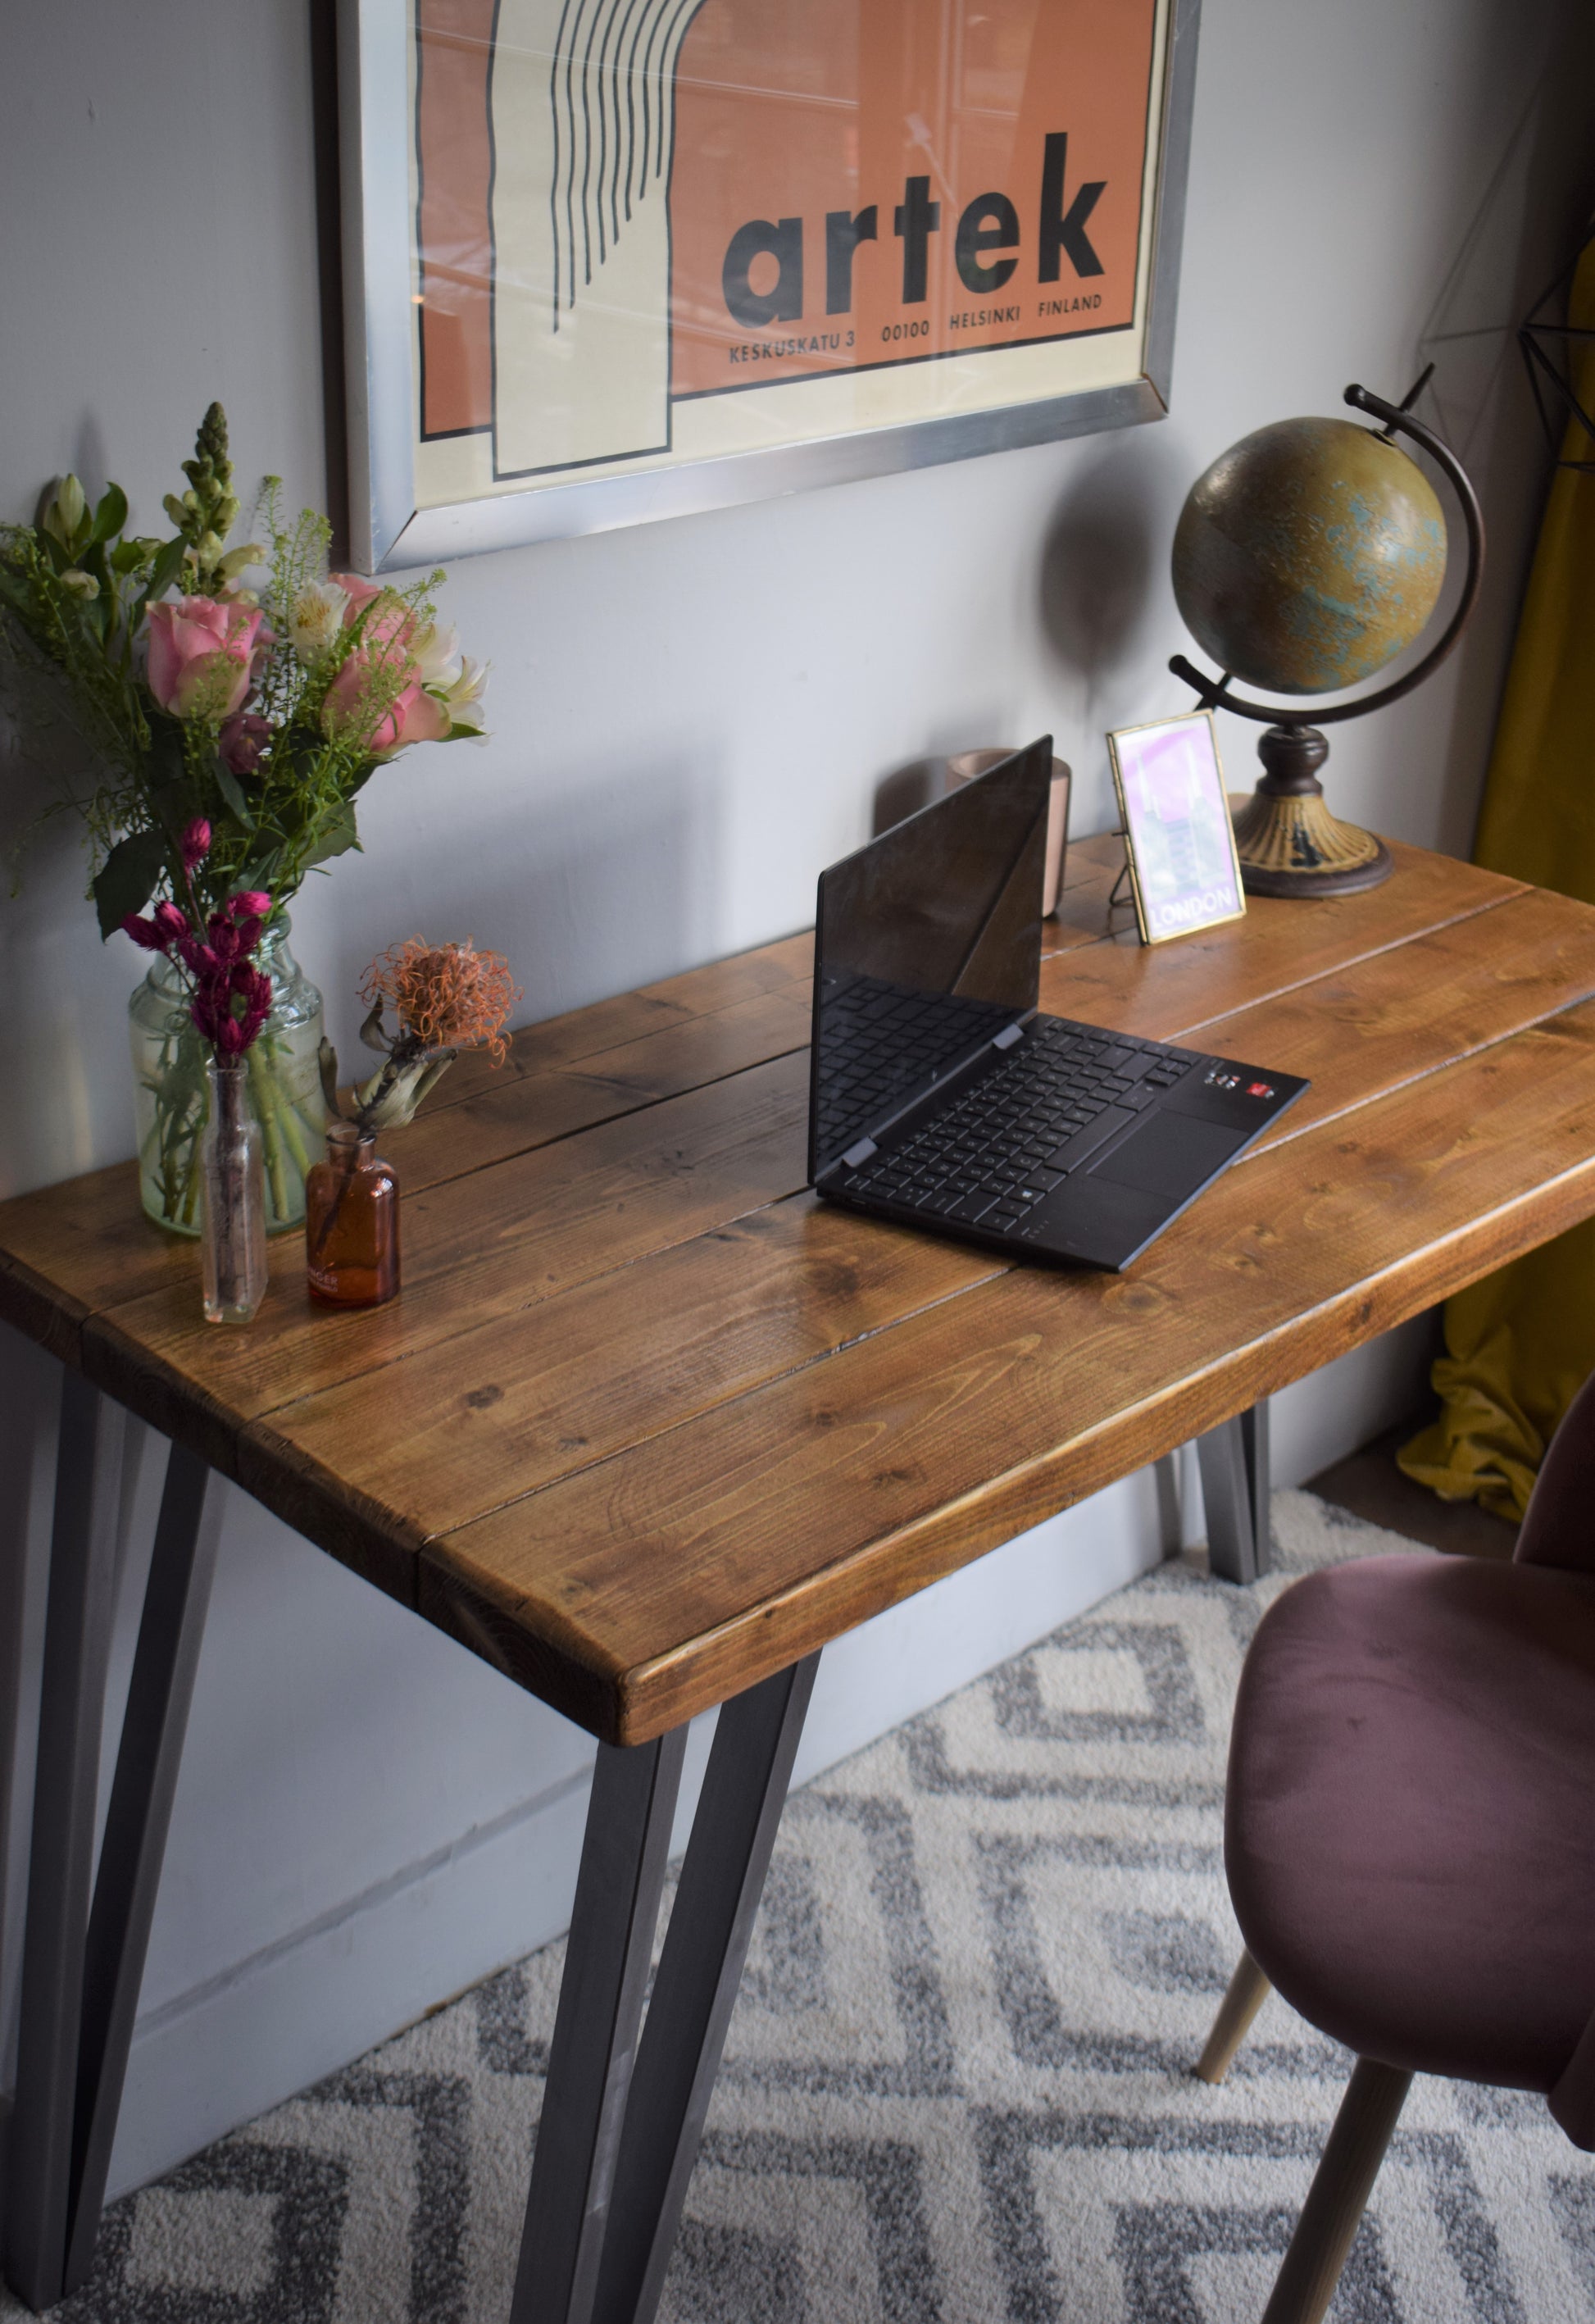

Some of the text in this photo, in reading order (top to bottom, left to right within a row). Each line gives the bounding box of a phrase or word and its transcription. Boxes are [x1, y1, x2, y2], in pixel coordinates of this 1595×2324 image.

[722, 132, 1108, 329] artek
[729, 293, 1102, 364] KESKUSKATU 3 00100 HELSINKI FINLAND
[1150, 886, 1233, 928] LONDON
